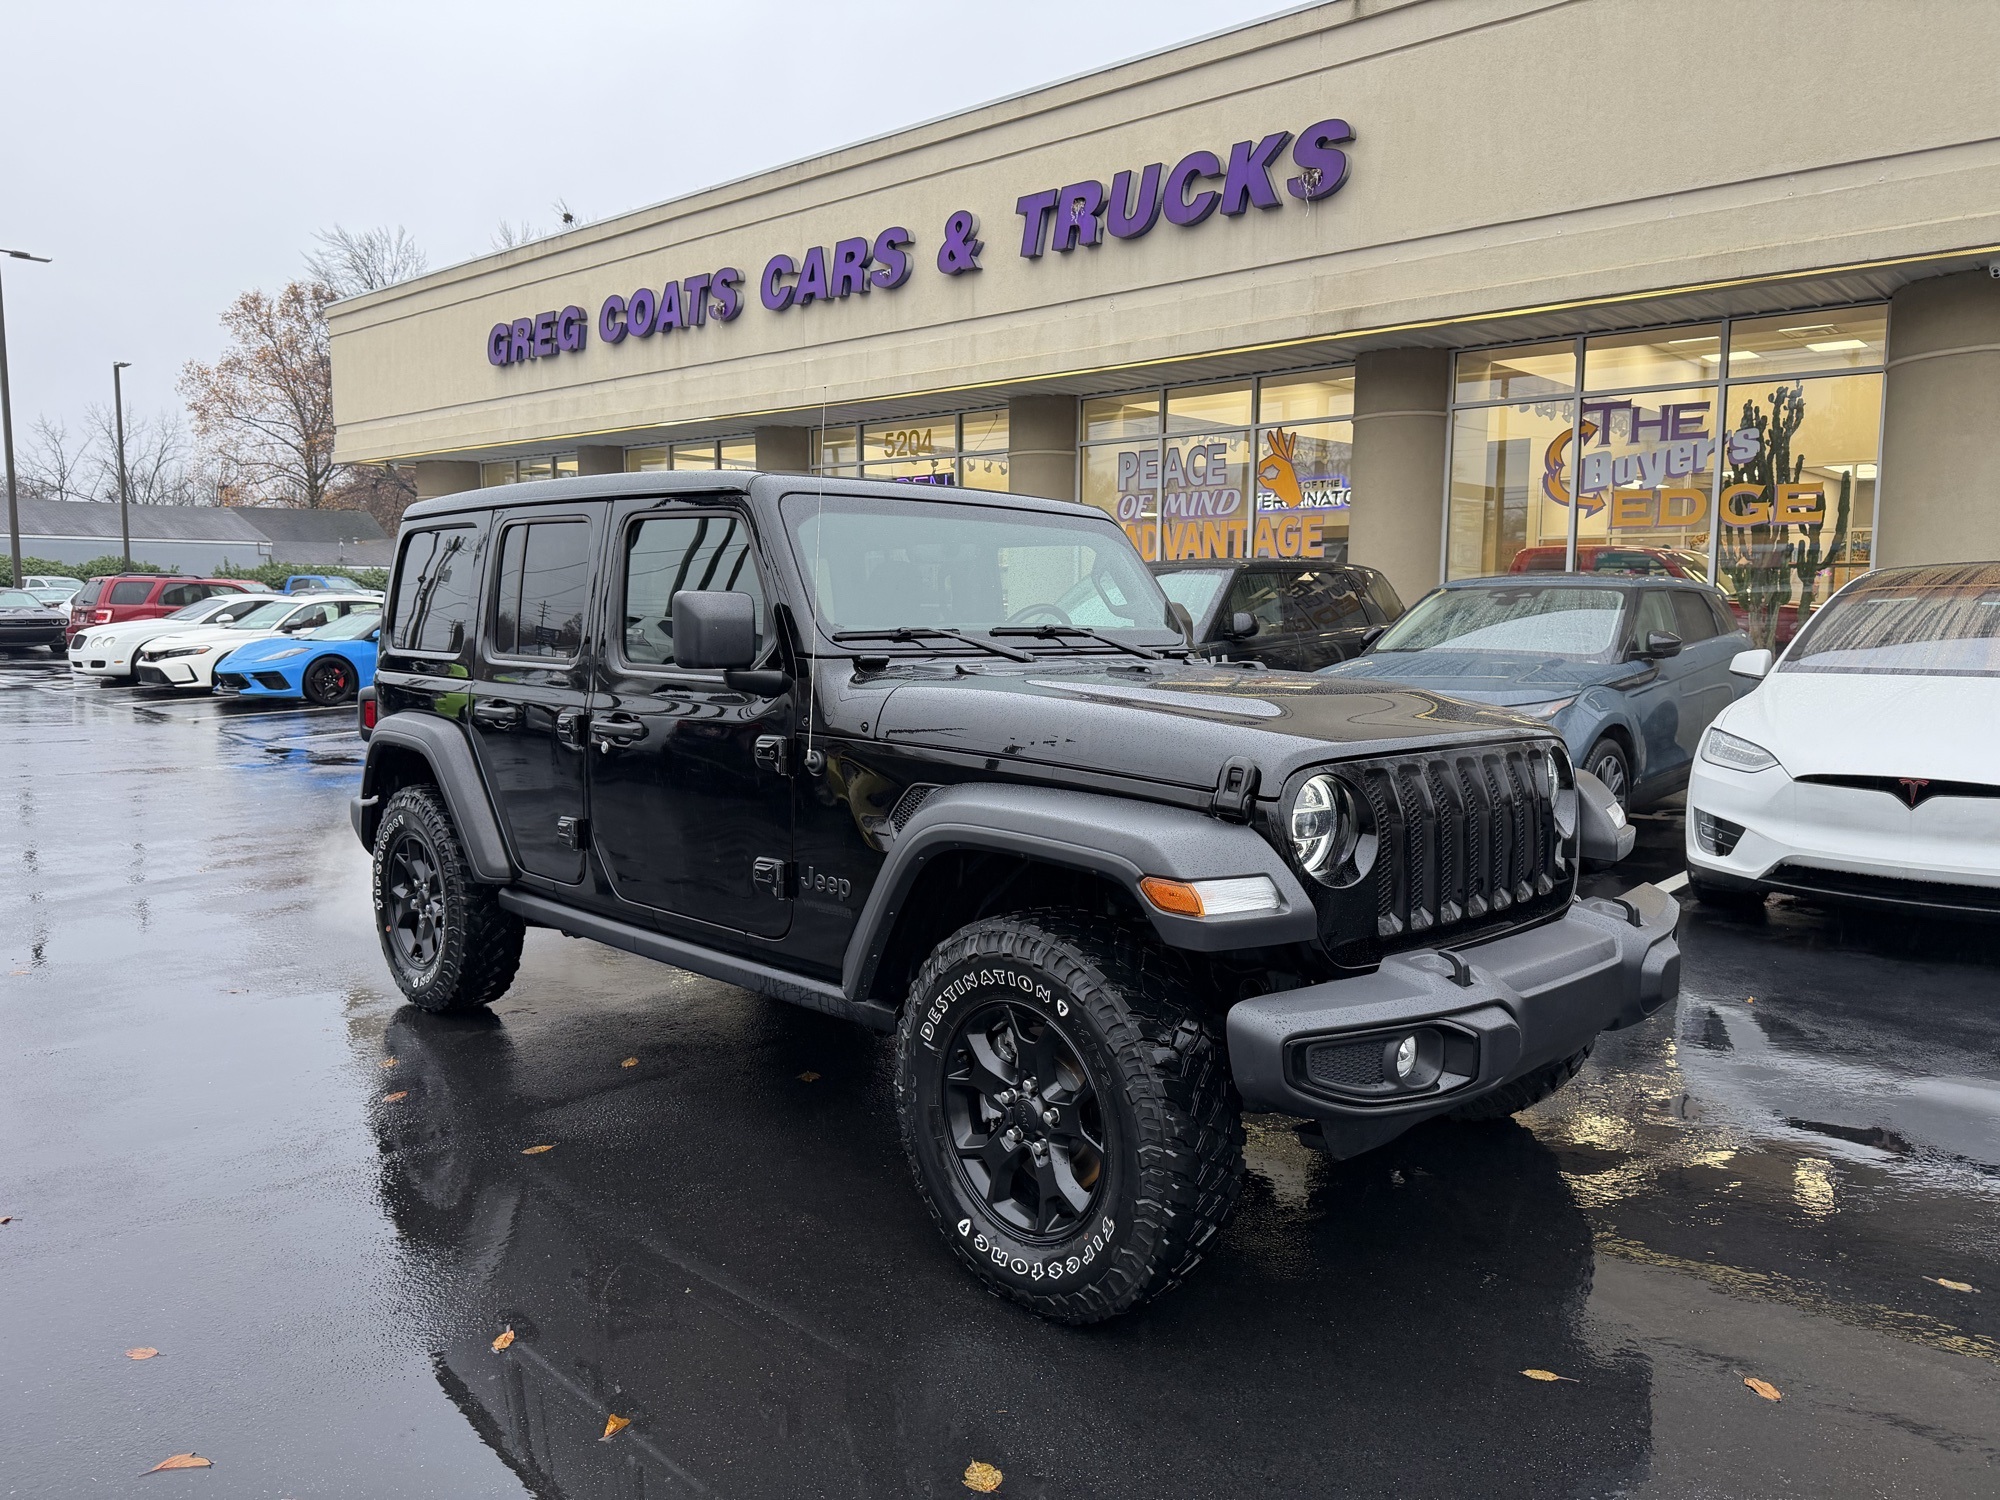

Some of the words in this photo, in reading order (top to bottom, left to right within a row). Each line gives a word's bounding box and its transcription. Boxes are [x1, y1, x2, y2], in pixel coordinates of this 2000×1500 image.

[487, 305, 587, 366] GREG
[599, 267, 745, 344] COATS
[760, 226, 915, 311] CARS
[937, 210, 984, 275] &
[1016, 118, 1356, 259] TRUCKS
[884, 429, 933, 458] 5204
[1583, 398, 1710, 447] THE
[1118, 443, 1227, 492] PEACE
[1117, 493, 1153, 521] OF
[1162, 489, 1241, 519] MIND
[1608, 482, 1826, 530] EDGE
[1124, 515, 1325, 562] ADVANTAGE
[801, 866, 851, 901] Jeep
[920, 970, 1051, 1042] DESTINATION
[974, 1216, 1116, 1281] Firestone
